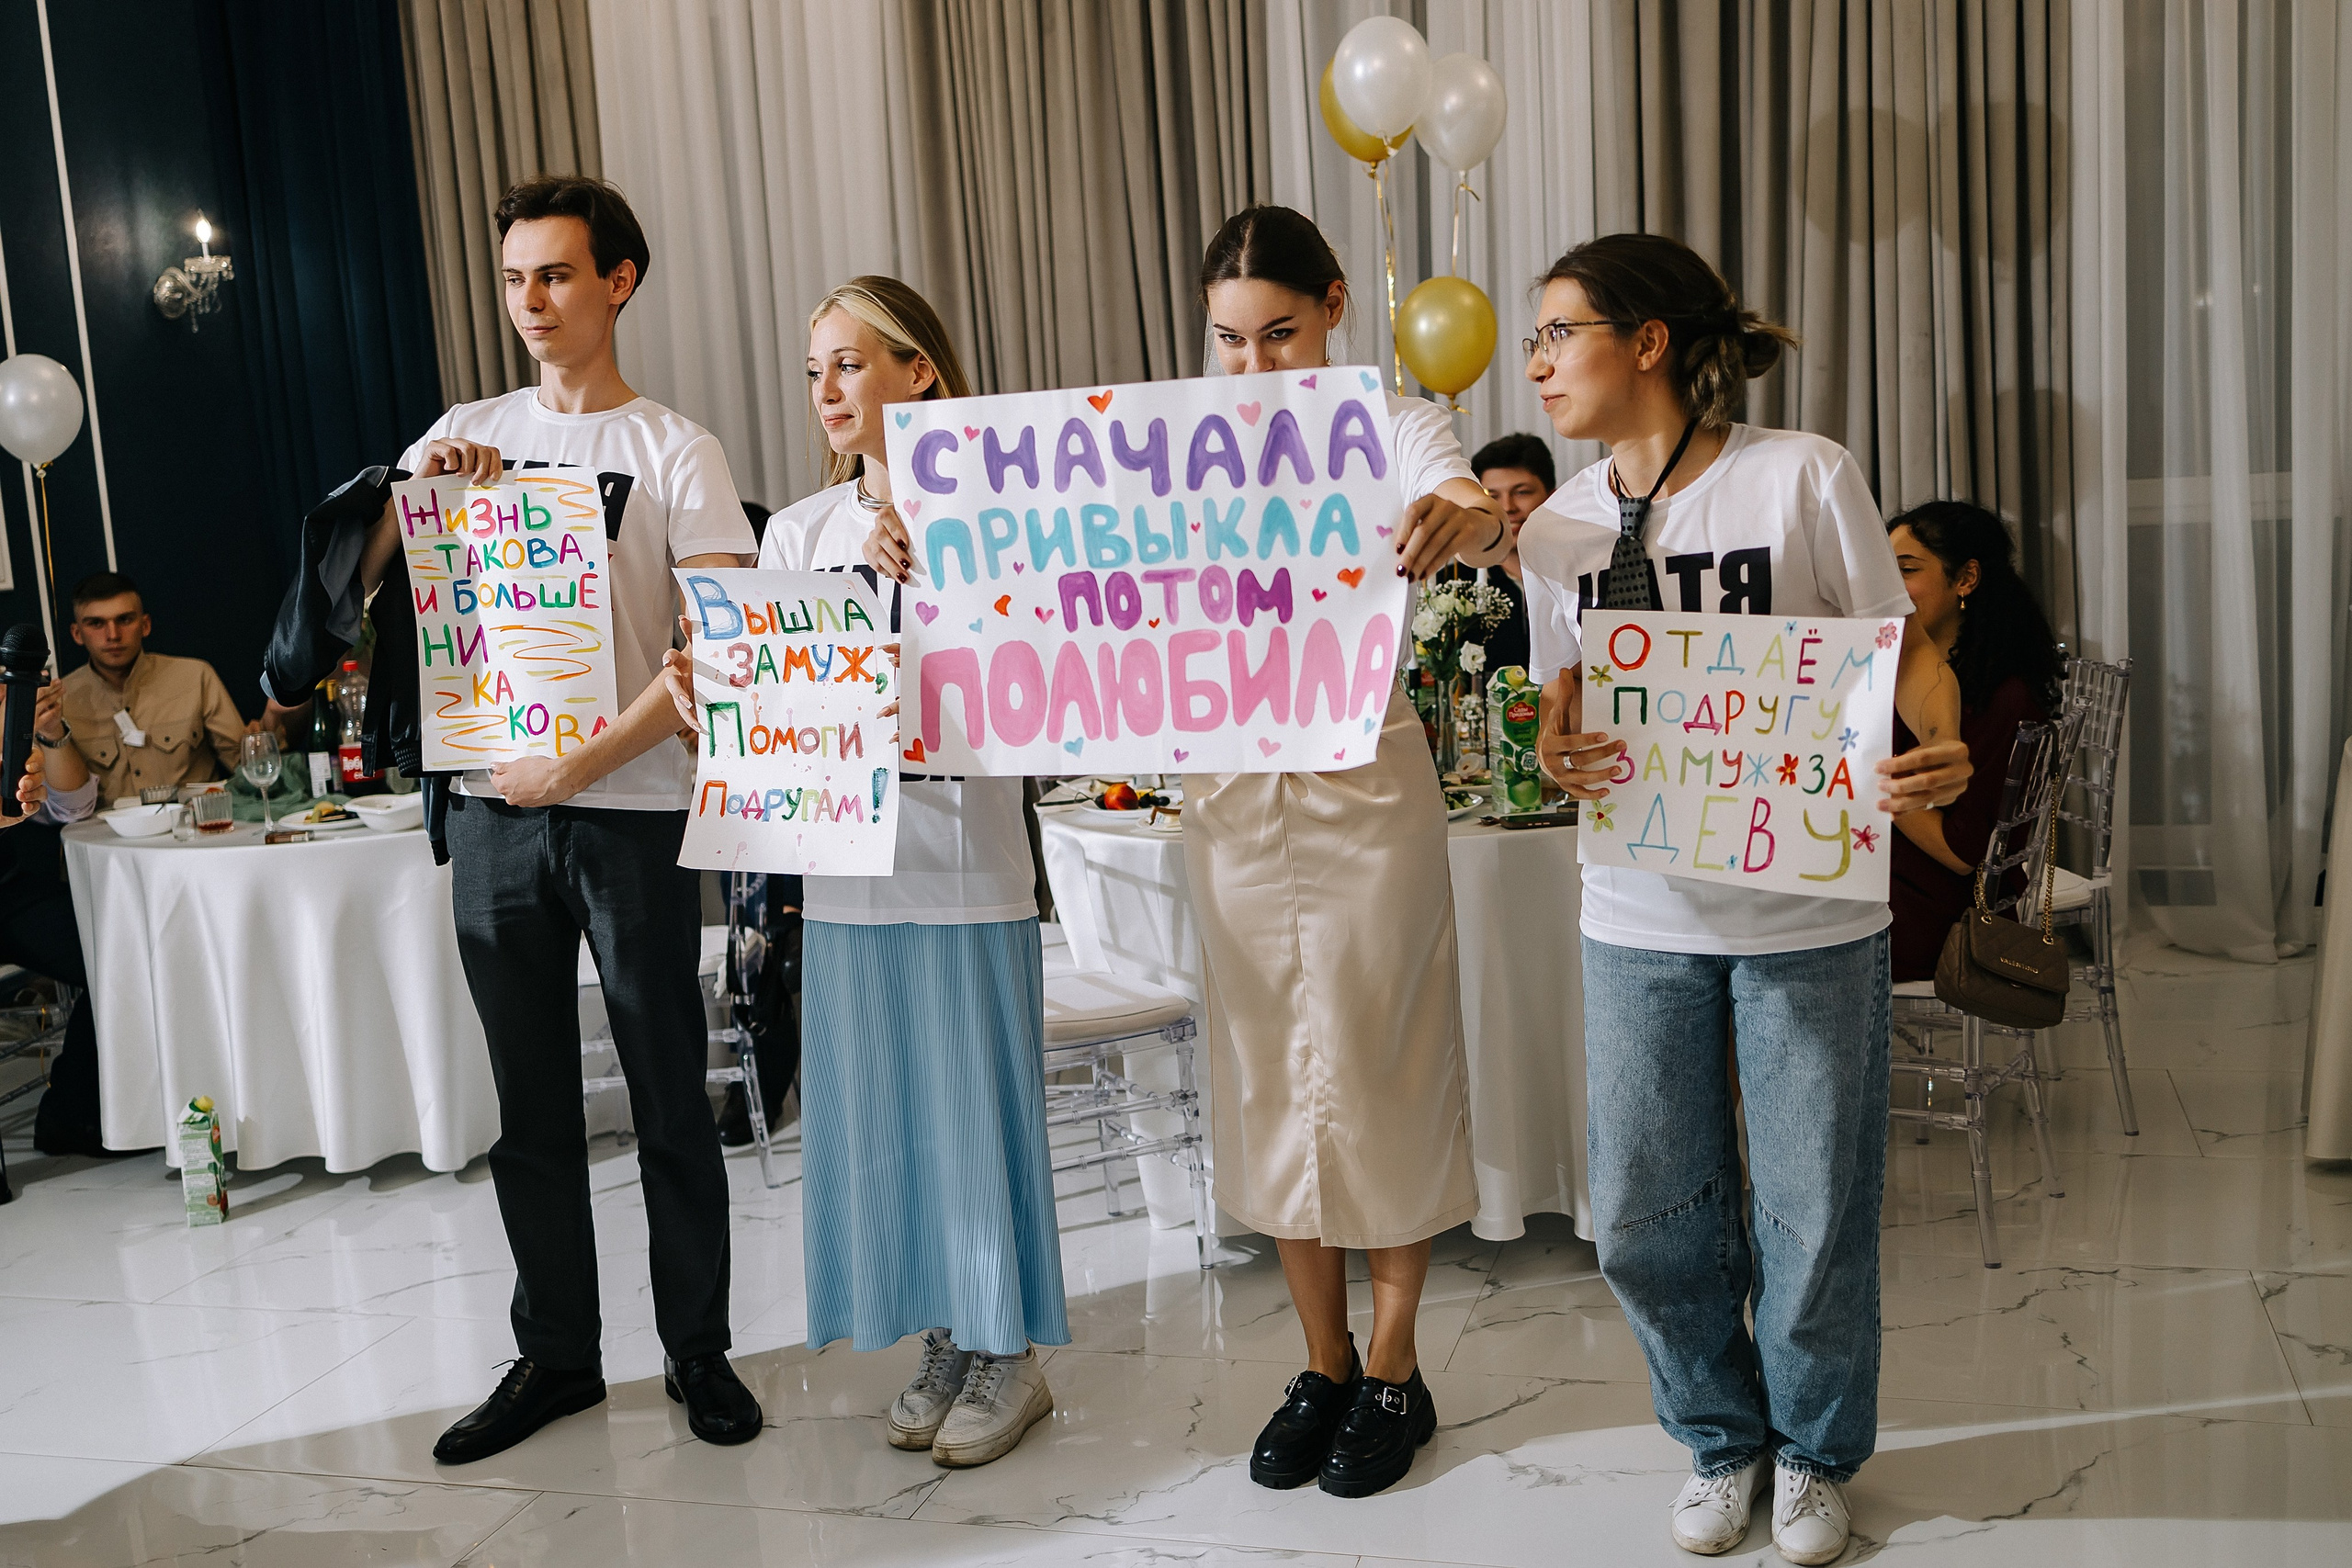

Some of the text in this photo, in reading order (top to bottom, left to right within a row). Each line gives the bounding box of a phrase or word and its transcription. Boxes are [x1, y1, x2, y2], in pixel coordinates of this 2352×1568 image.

[910, 399, 1387, 497] СНАЧАЛА
[434, 534, 595, 577] ТАКОВА,
[925, 492, 1361, 592] ПРИВЫКЛА
[414, 572, 599, 615] И БОЛЬШЕ
[1057, 564, 1293, 633] ПОТОМ
[1577, 547, 1772, 621] ТЯ
[423, 623, 488, 668] НИ
[727, 642, 888, 694] ЗАМУЖ,
[1608, 623, 1873, 692] ОТДАЁМ
[472, 671, 514, 707] КА
[920, 613, 1395, 753] ПОЛЮБИЛА
[1613, 686, 1841, 740] ПОДРУГУ
[1608, 742, 1854, 800] ЗАМУЖ ЗА
[1626, 793, 1851, 882] ДЕВУ
[1999, 956, 2039, 974] VALENTINO
